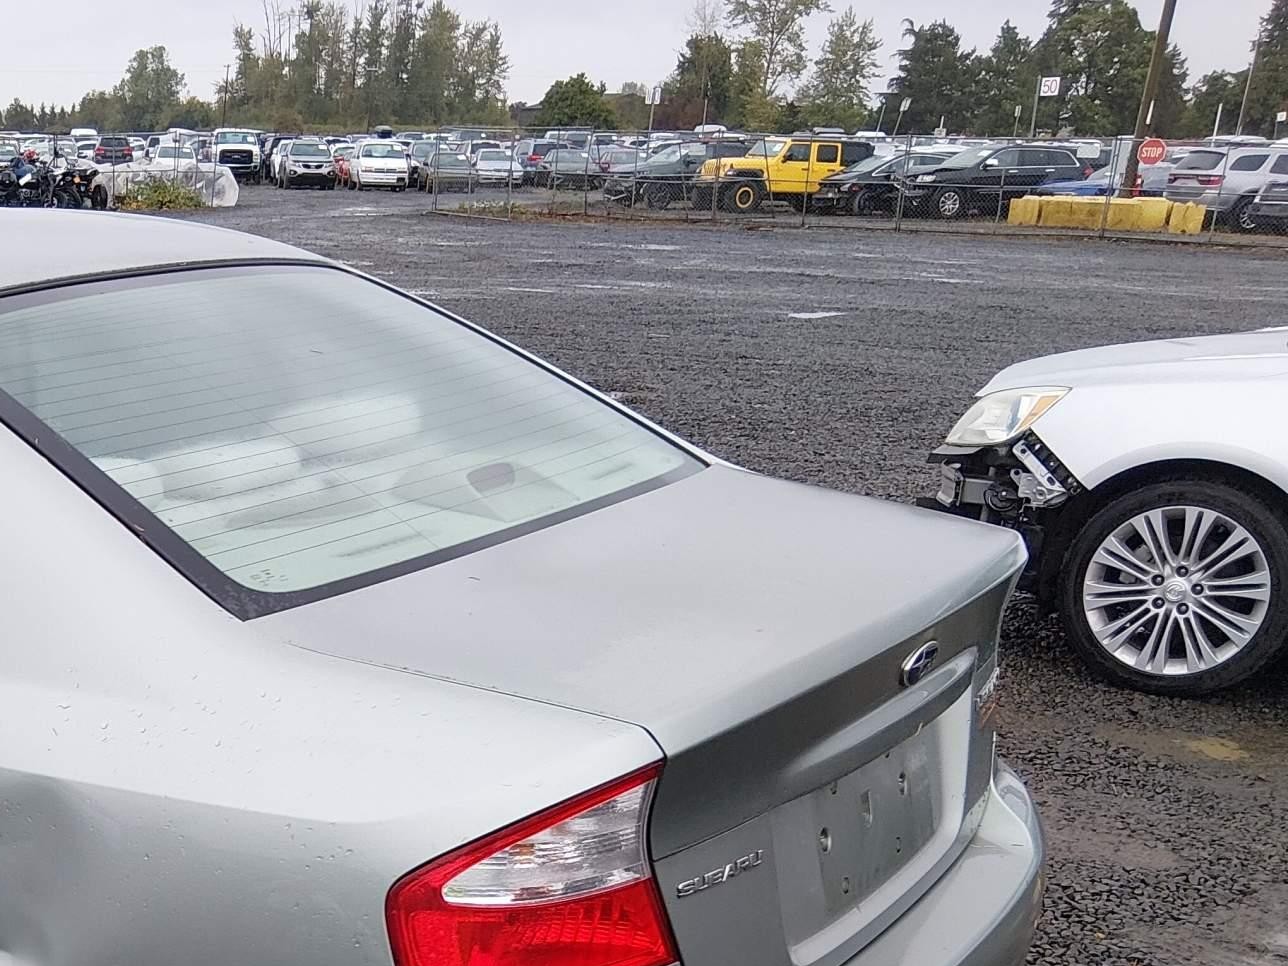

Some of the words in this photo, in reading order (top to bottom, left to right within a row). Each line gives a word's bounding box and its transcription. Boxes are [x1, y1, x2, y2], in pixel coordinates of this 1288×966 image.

[1042, 79, 1059, 94] 50
[1141, 146, 1162, 158] STOP
[676, 849, 764, 899] SUBARU
